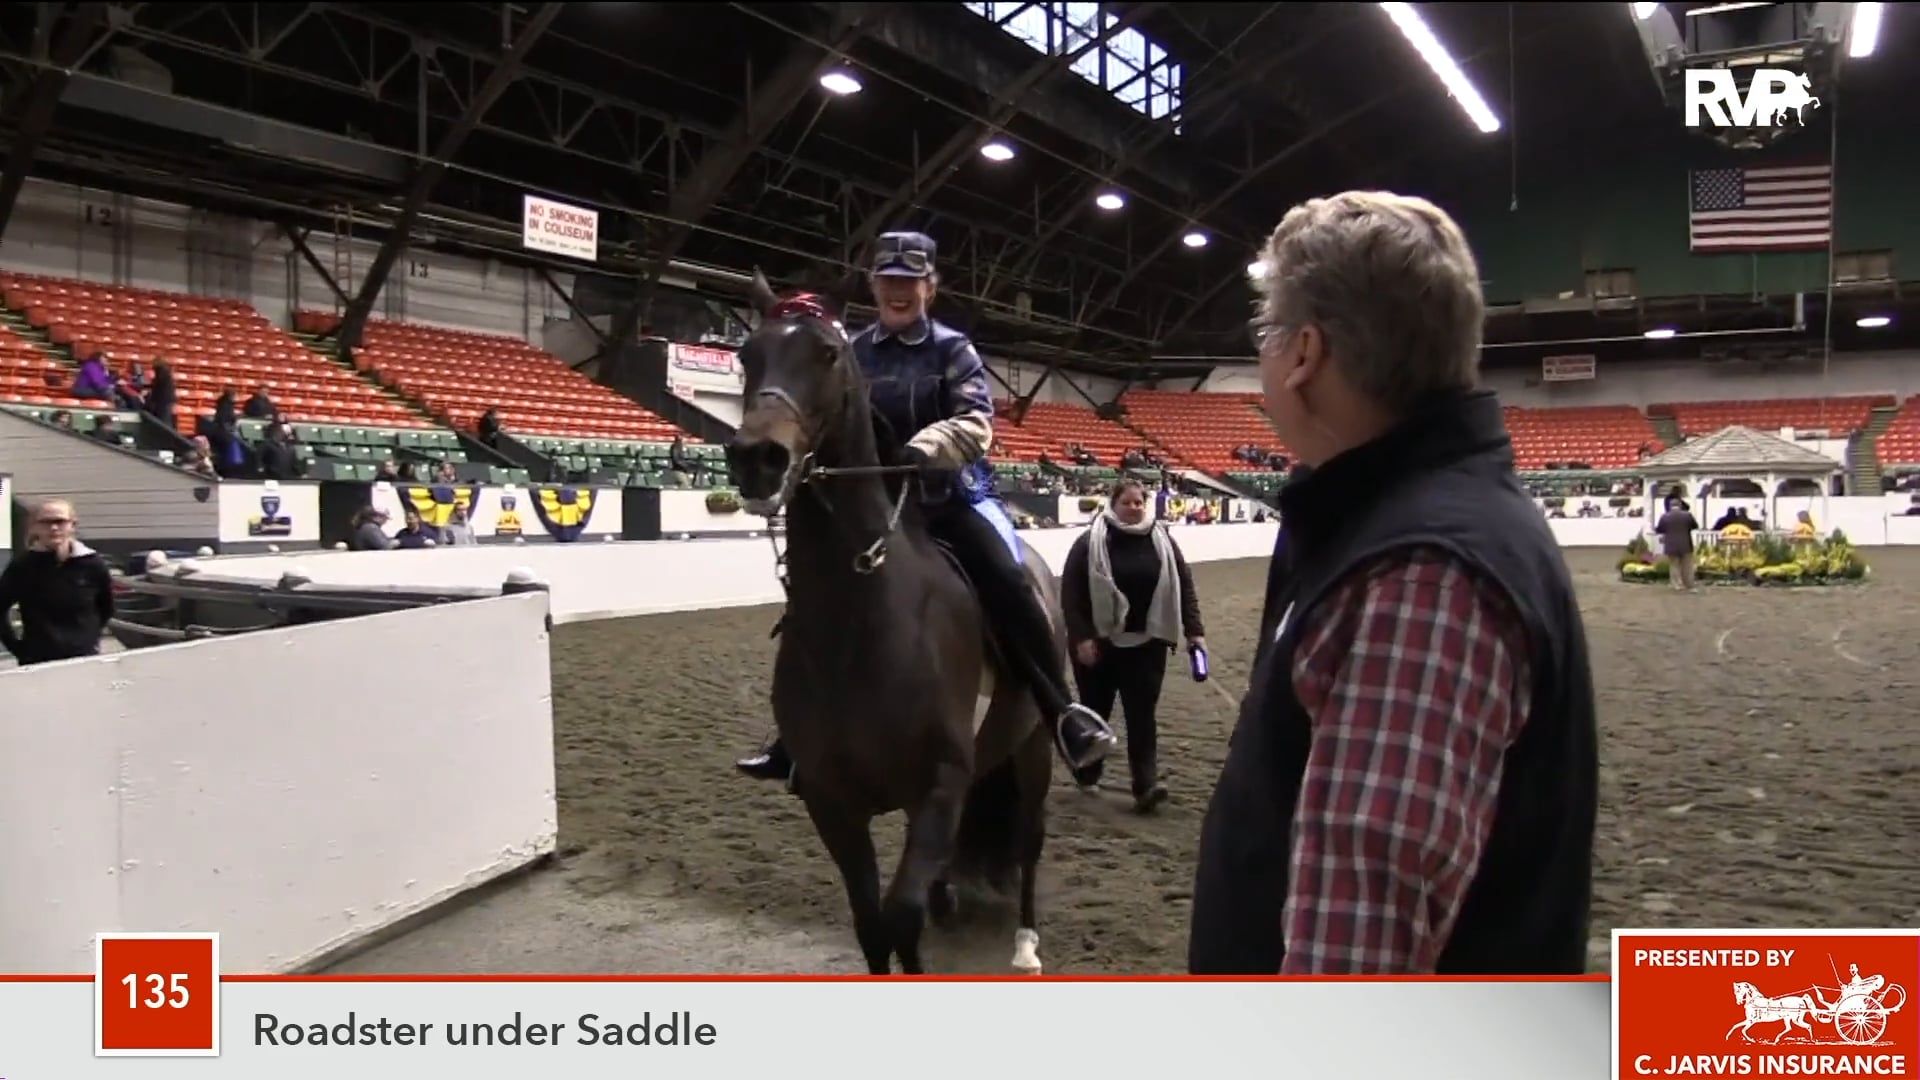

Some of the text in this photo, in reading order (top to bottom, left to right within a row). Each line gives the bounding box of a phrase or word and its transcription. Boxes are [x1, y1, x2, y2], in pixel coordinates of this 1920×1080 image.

[86, 204, 112, 227] 12
[530, 204, 594, 228] NO SMOKING
[529, 217, 594, 241] IN COLISEUM
[410, 260, 429, 278] 13
